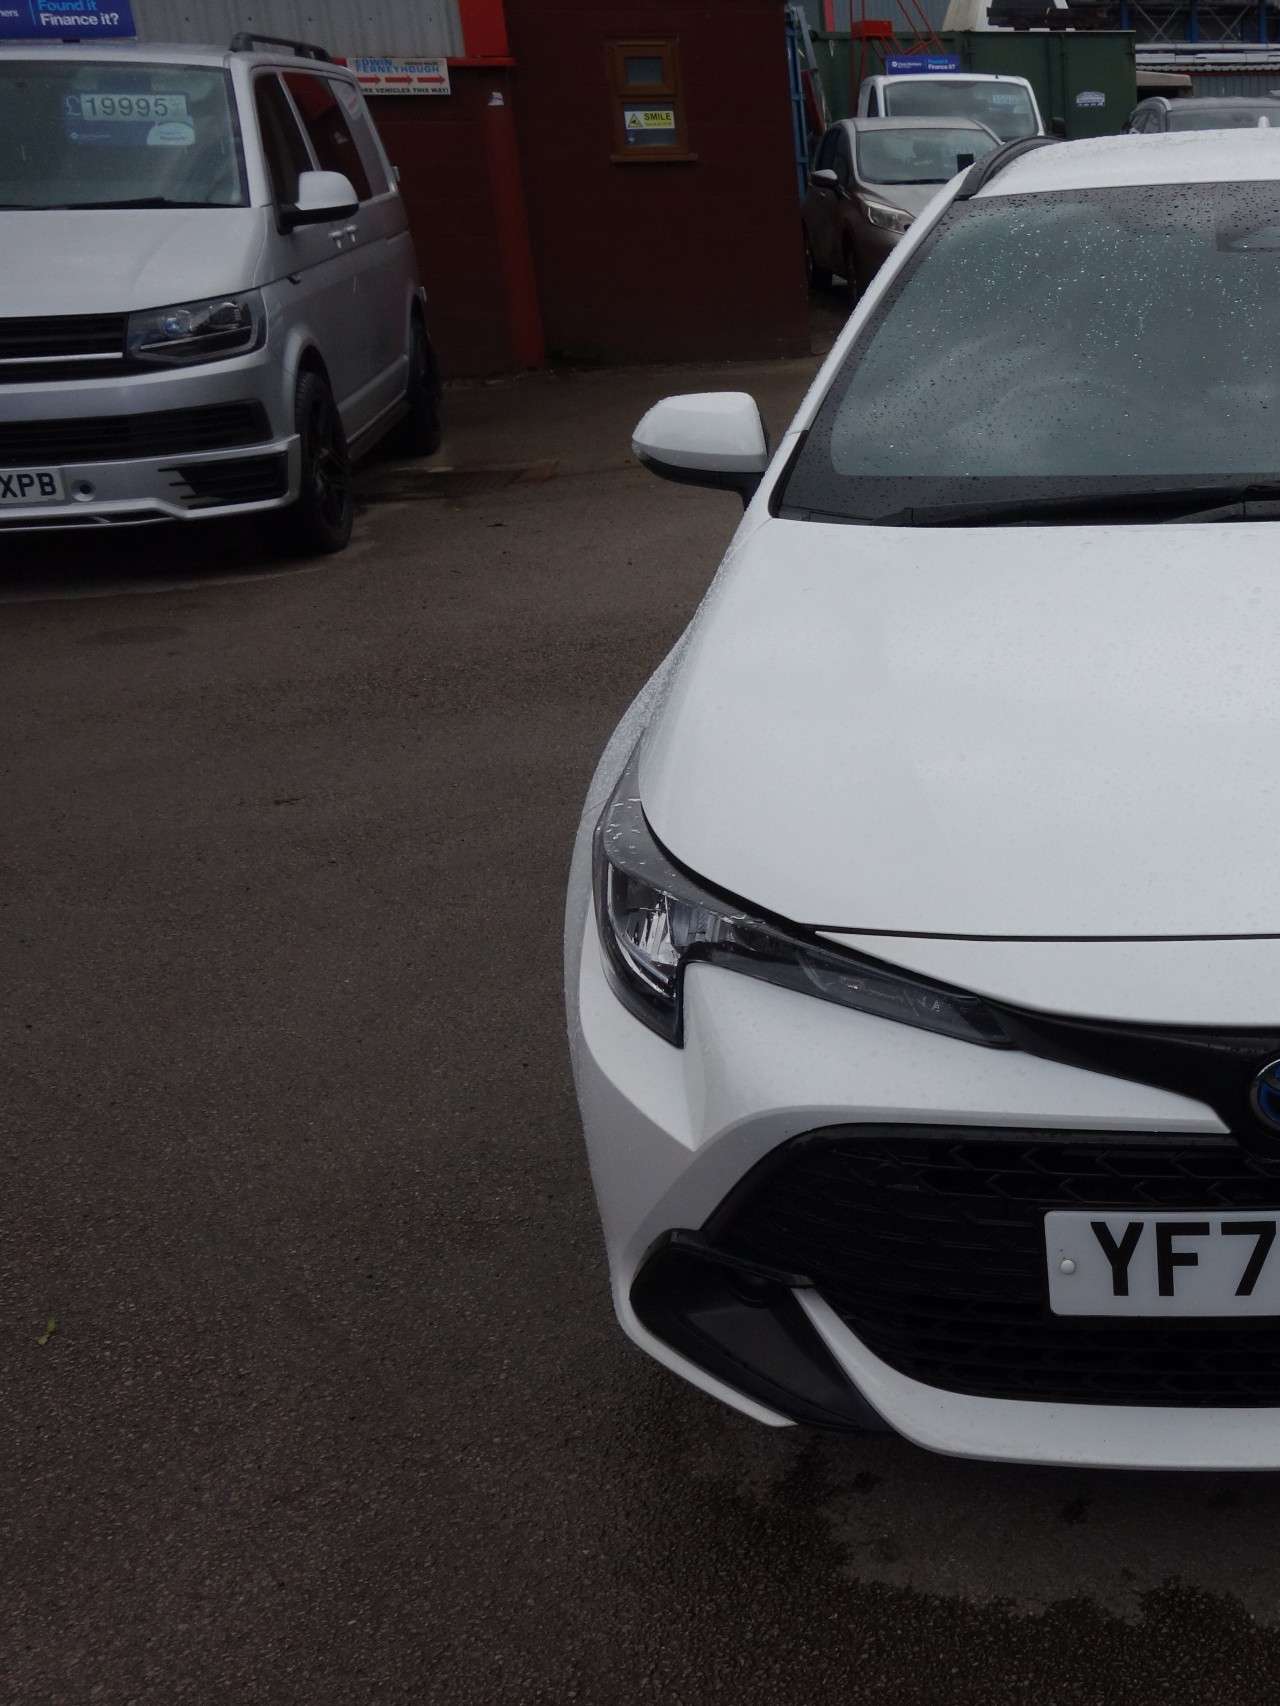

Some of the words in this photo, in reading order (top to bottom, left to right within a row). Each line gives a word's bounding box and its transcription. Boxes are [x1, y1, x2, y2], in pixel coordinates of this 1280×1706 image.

[39, 0, 84, 11] Found
[40, 13, 98, 26] Finance
[100, 12, 119, 25] it?
[644, 113, 672, 121] SMILE
[0, 472, 57, 499] XPB
